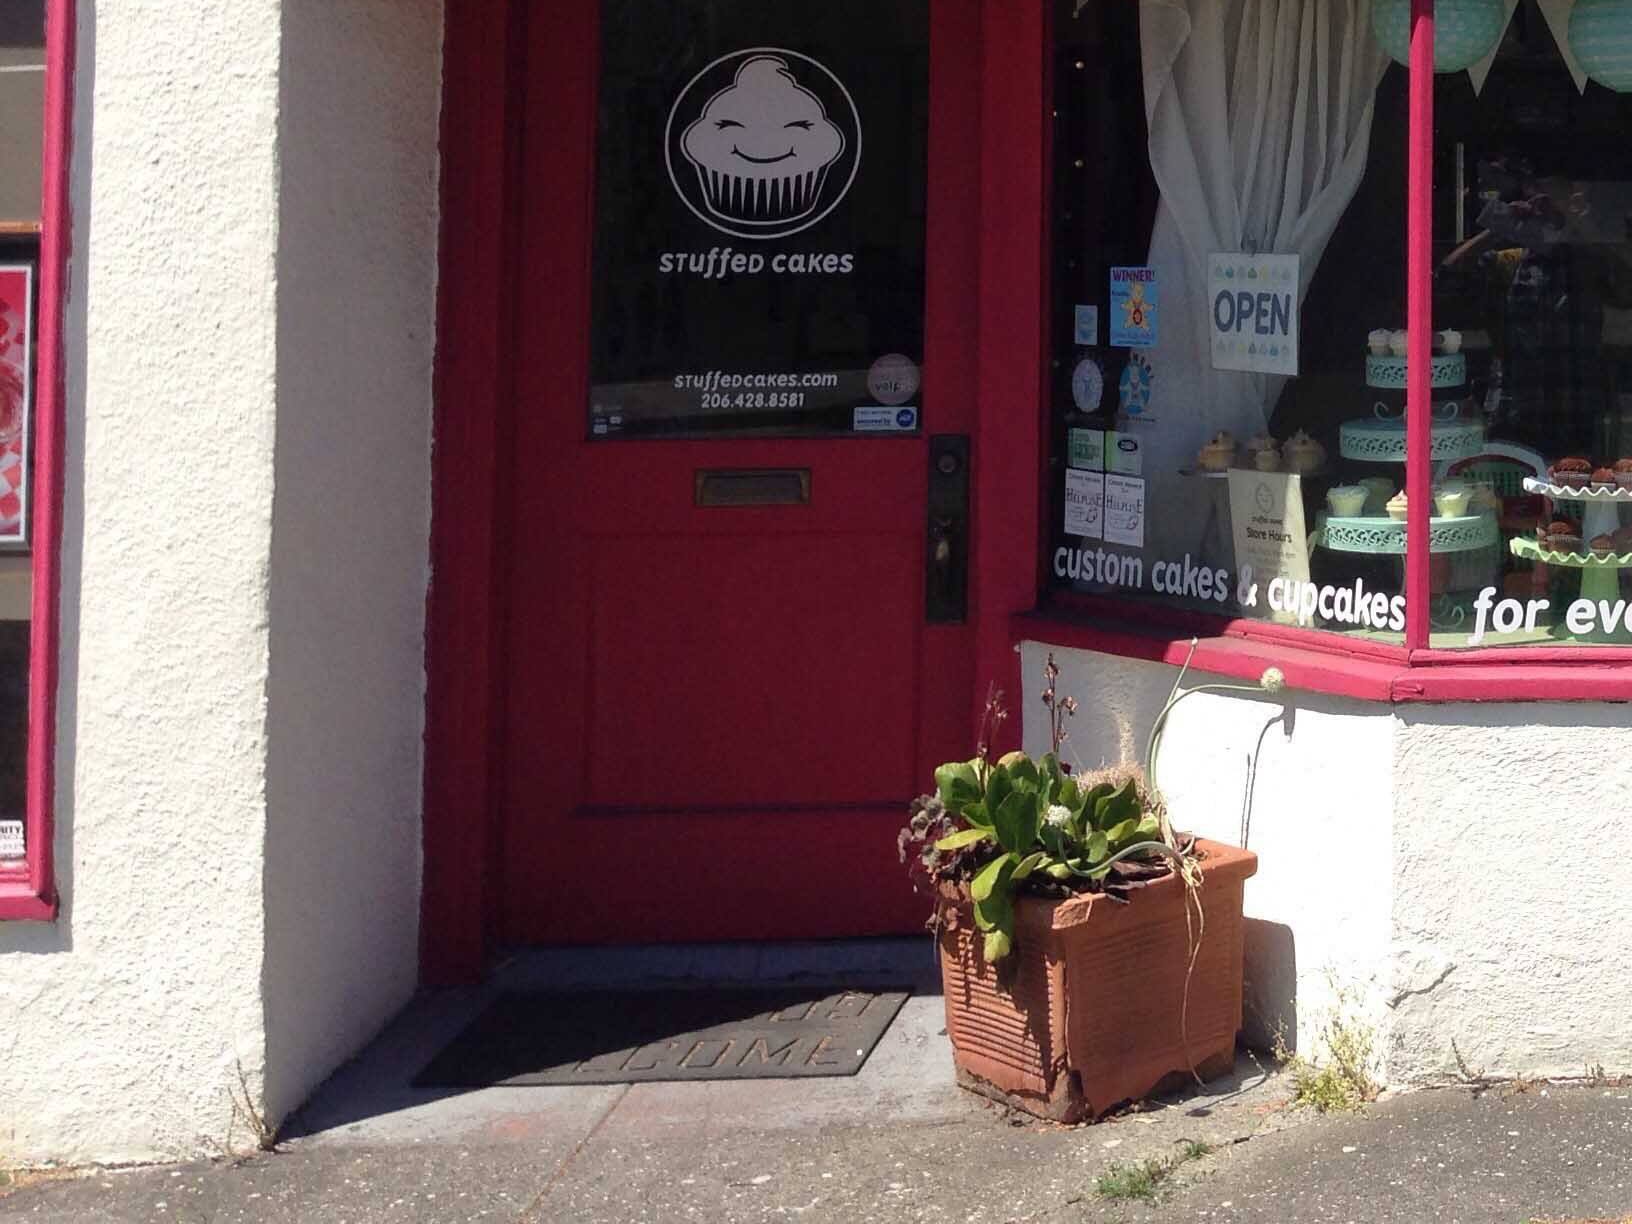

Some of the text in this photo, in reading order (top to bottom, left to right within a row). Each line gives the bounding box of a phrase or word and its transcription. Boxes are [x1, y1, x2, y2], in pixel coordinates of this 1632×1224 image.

[1213, 289, 1291, 337] OPEN
[701, 387, 805, 409] 206.428.8581
[1246, 527, 1293, 543] Store Hours
[1053, 546, 1143, 589] custom
[1151, 553, 1229, 603] cakes
[1237, 564, 1257, 608] &
[1268, 577, 1405, 631] cupcakes
[1470, 587, 1550, 646] for
